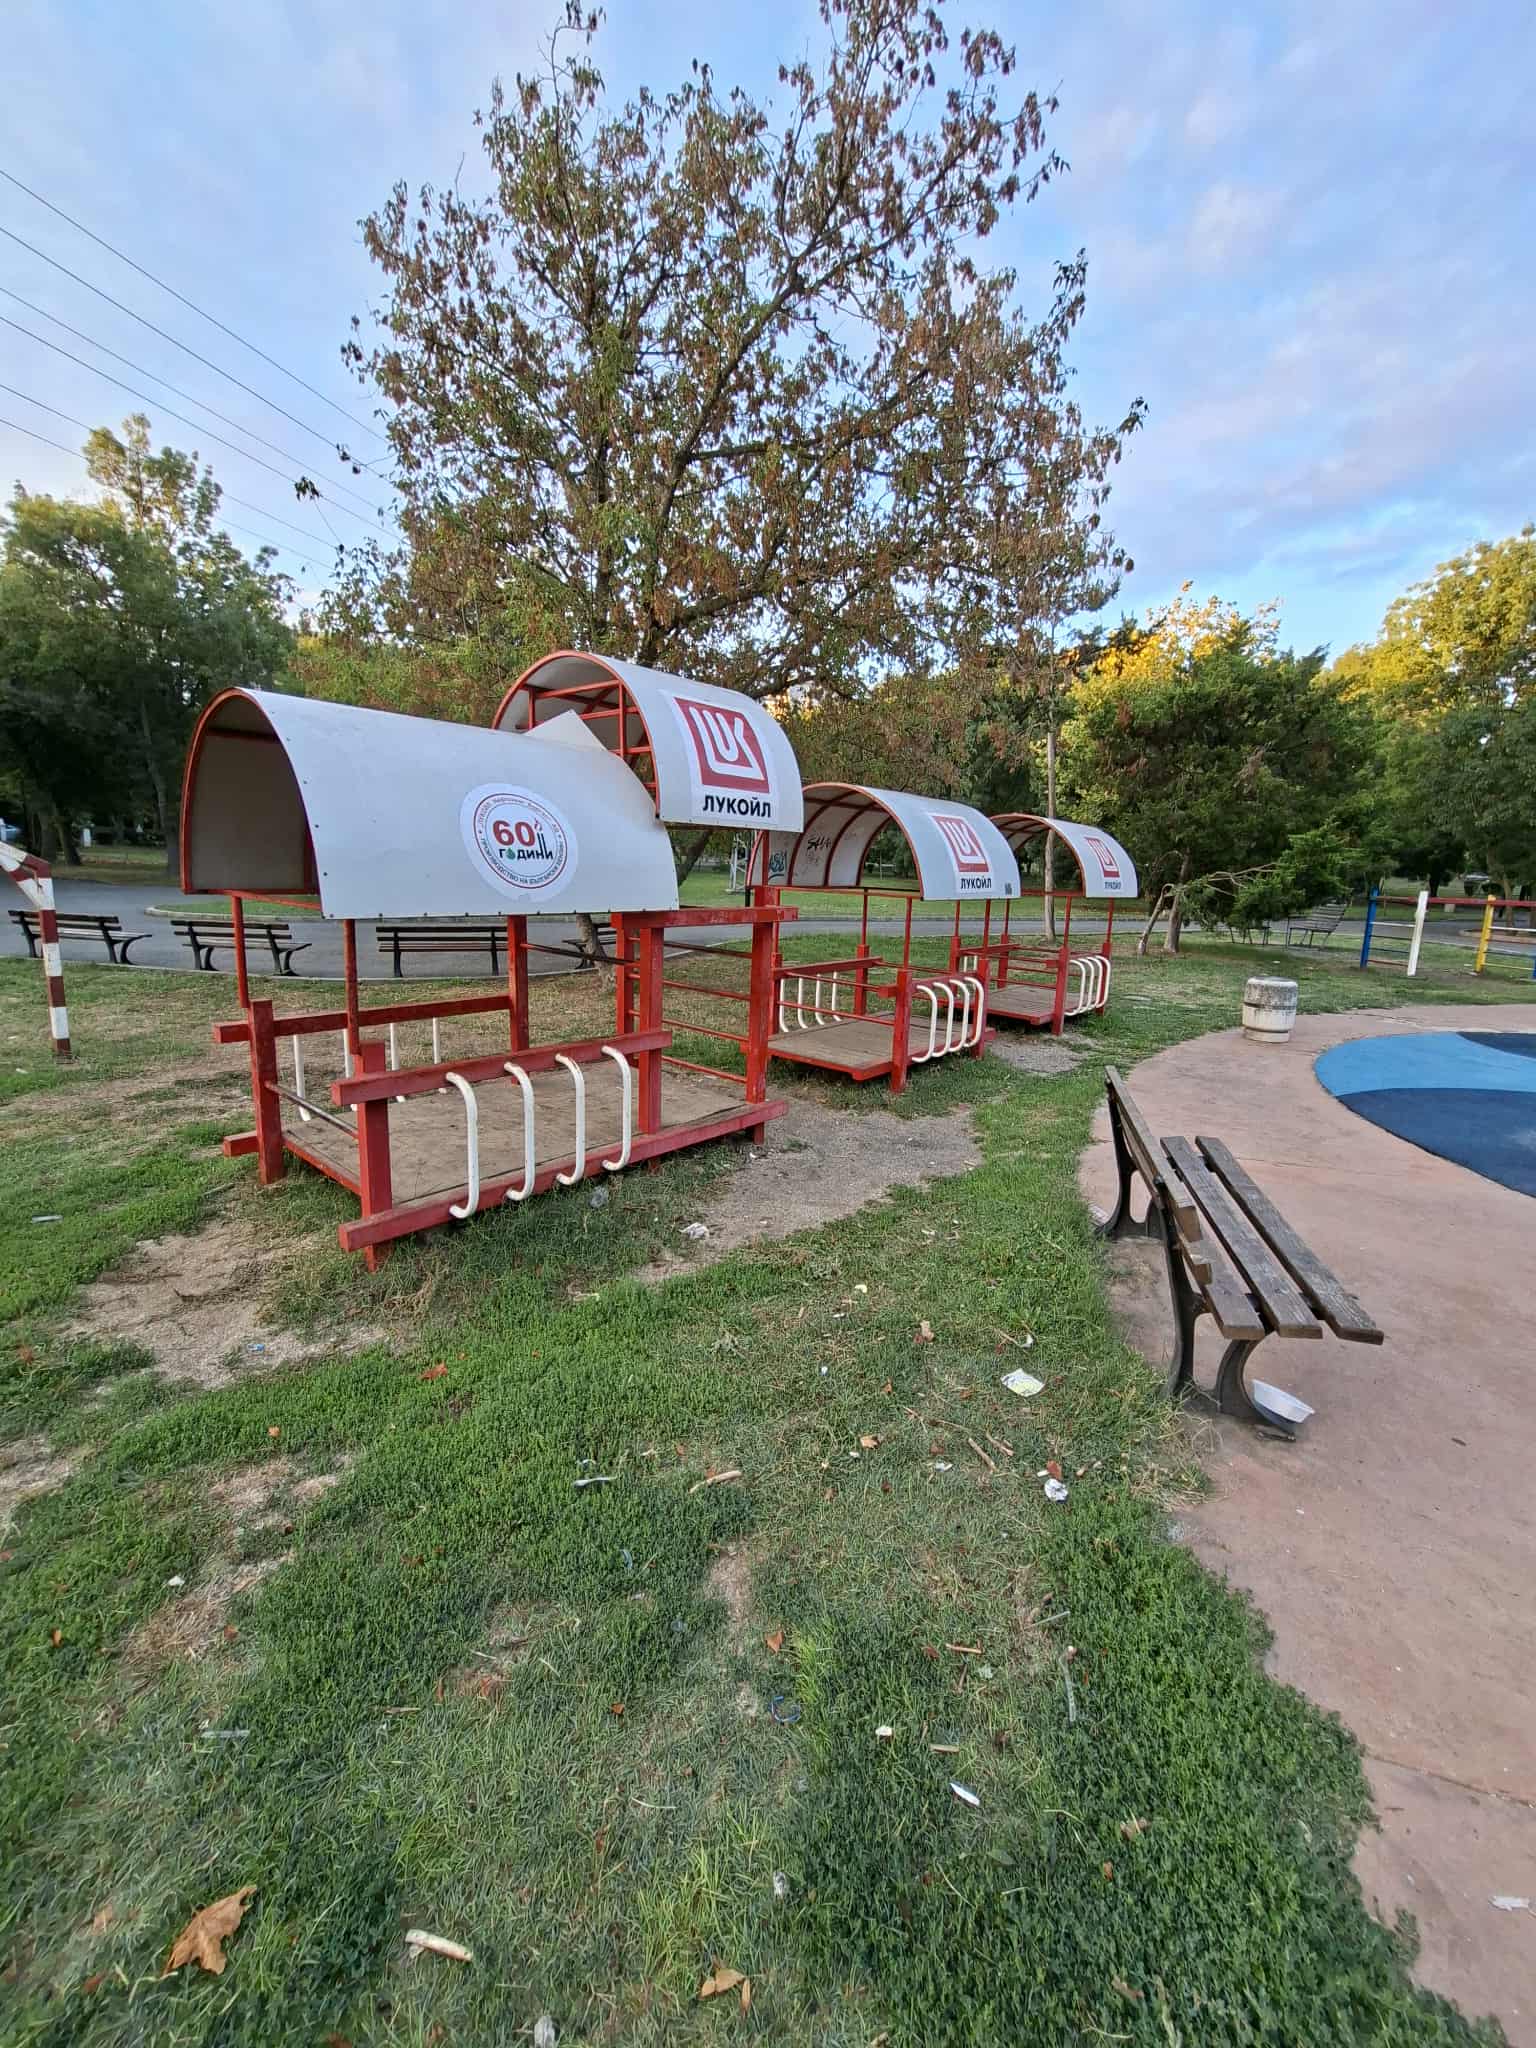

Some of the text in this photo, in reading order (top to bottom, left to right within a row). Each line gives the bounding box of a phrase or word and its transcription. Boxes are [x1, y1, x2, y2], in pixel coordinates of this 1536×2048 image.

[702, 794, 771, 818] ЛУКОЙЛ
[492, 819, 536, 847] 60
[960, 875, 992, 890] ЛУКОЙЛ
